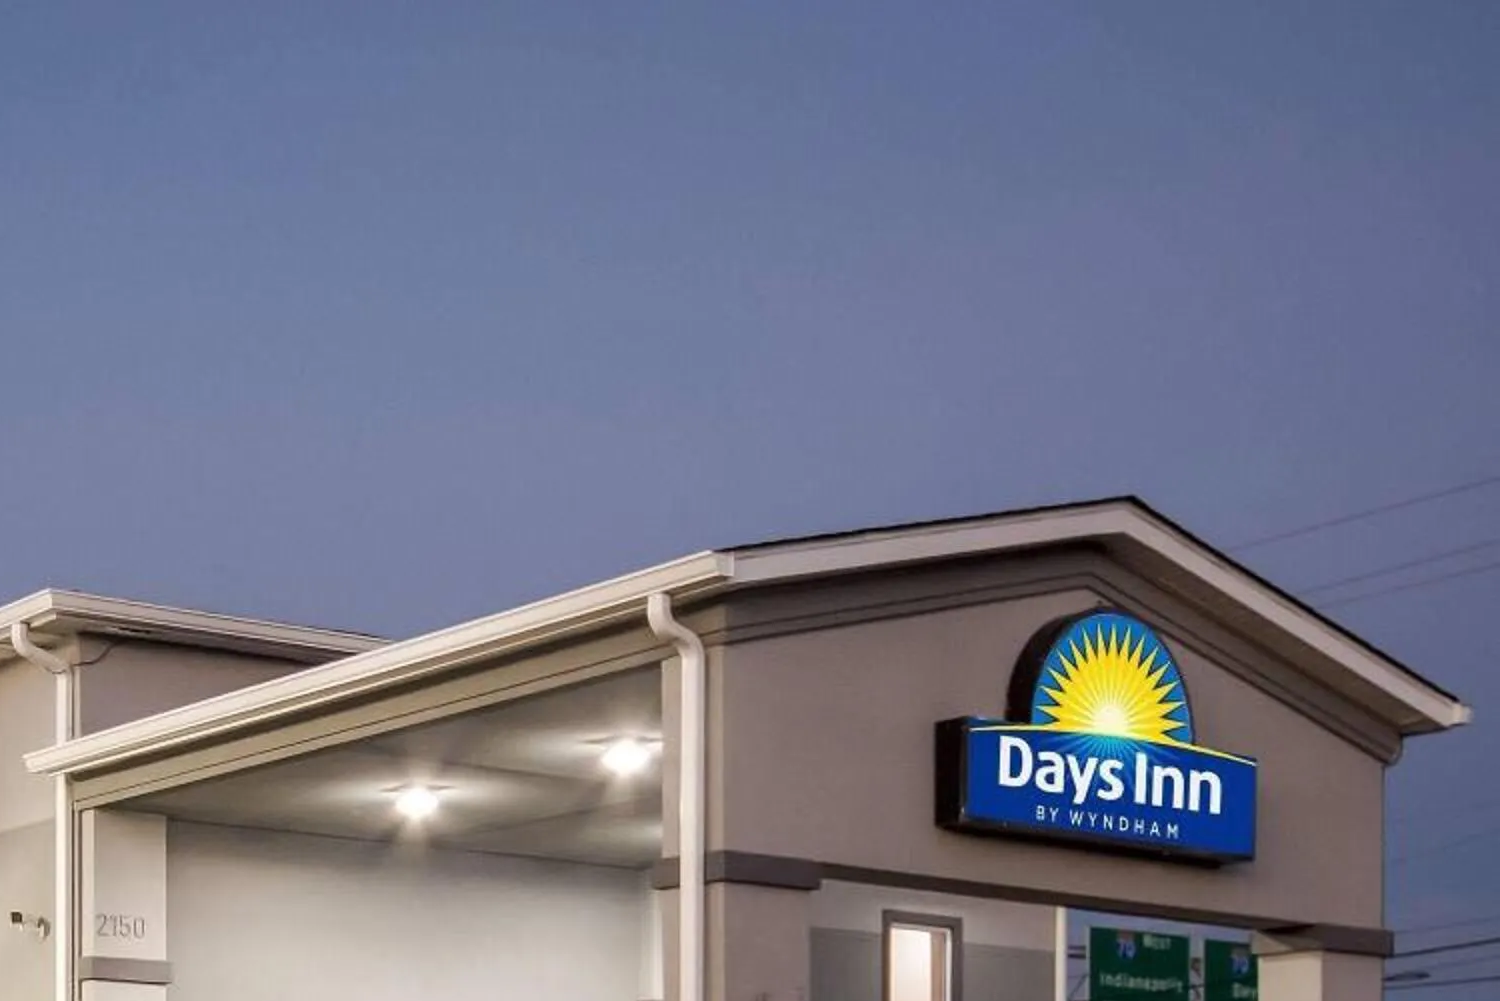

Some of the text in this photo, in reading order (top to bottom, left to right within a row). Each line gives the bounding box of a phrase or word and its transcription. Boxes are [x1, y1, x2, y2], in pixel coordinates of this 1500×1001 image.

[998, 735, 1222, 815] Days Inn
[1036, 805, 1179, 839] BY WYNDHAM
[96, 912, 146, 939] 2150
